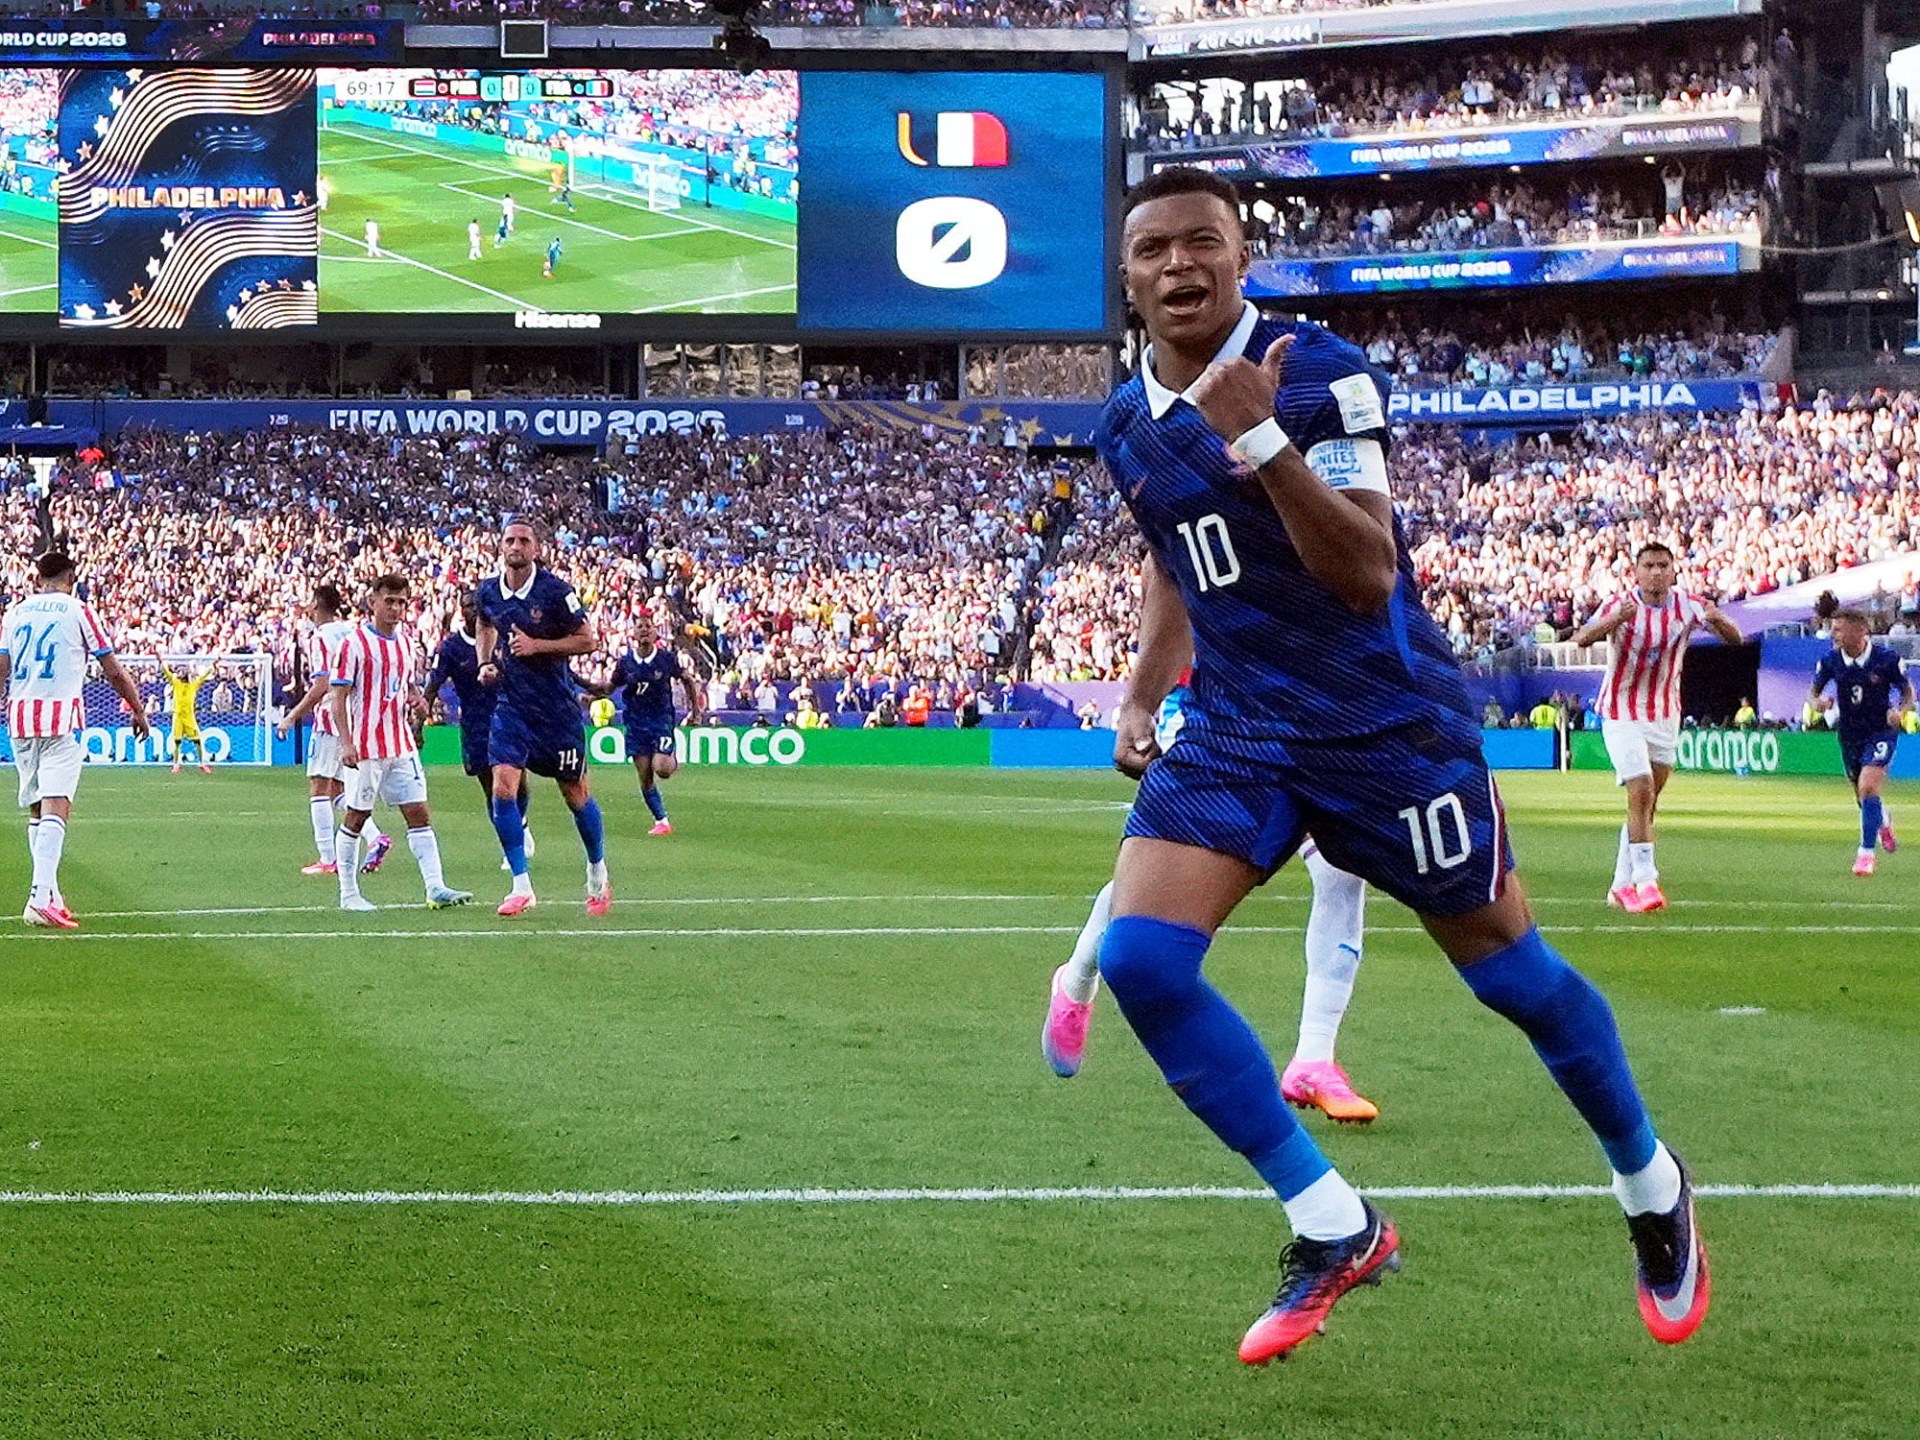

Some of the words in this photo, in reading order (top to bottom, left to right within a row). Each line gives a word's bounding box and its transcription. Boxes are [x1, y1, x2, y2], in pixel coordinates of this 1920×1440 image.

[0, 33, 34, 46] RLD
[36, 33, 69, 46] CUP
[70, 32, 127, 46] 2026
[347, 81, 395, 96] 69:17
[89, 186, 285, 209] PHILADELPHIA
[515, 311, 601, 328] Hisense
[1388, 383, 1696, 415] PHILADELPHIA
[329, 409, 398, 434] FIFA
[406, 409, 529, 435] WORLD
[534, 409, 601, 436] CUP
[1176, 513, 1241, 593] 10
[14, 621, 58, 680] 24
[636, 682, 650, 696] 17
[1851, 684, 1863, 704] 3
[590, 727, 805, 765] amco
[660, 736, 673, 752] 17
[1678, 730, 1778, 771] aramco
[1873, 741, 1889, 761] 3
[558, 748, 579, 771] 14
[1398, 792, 1472, 875] 10
